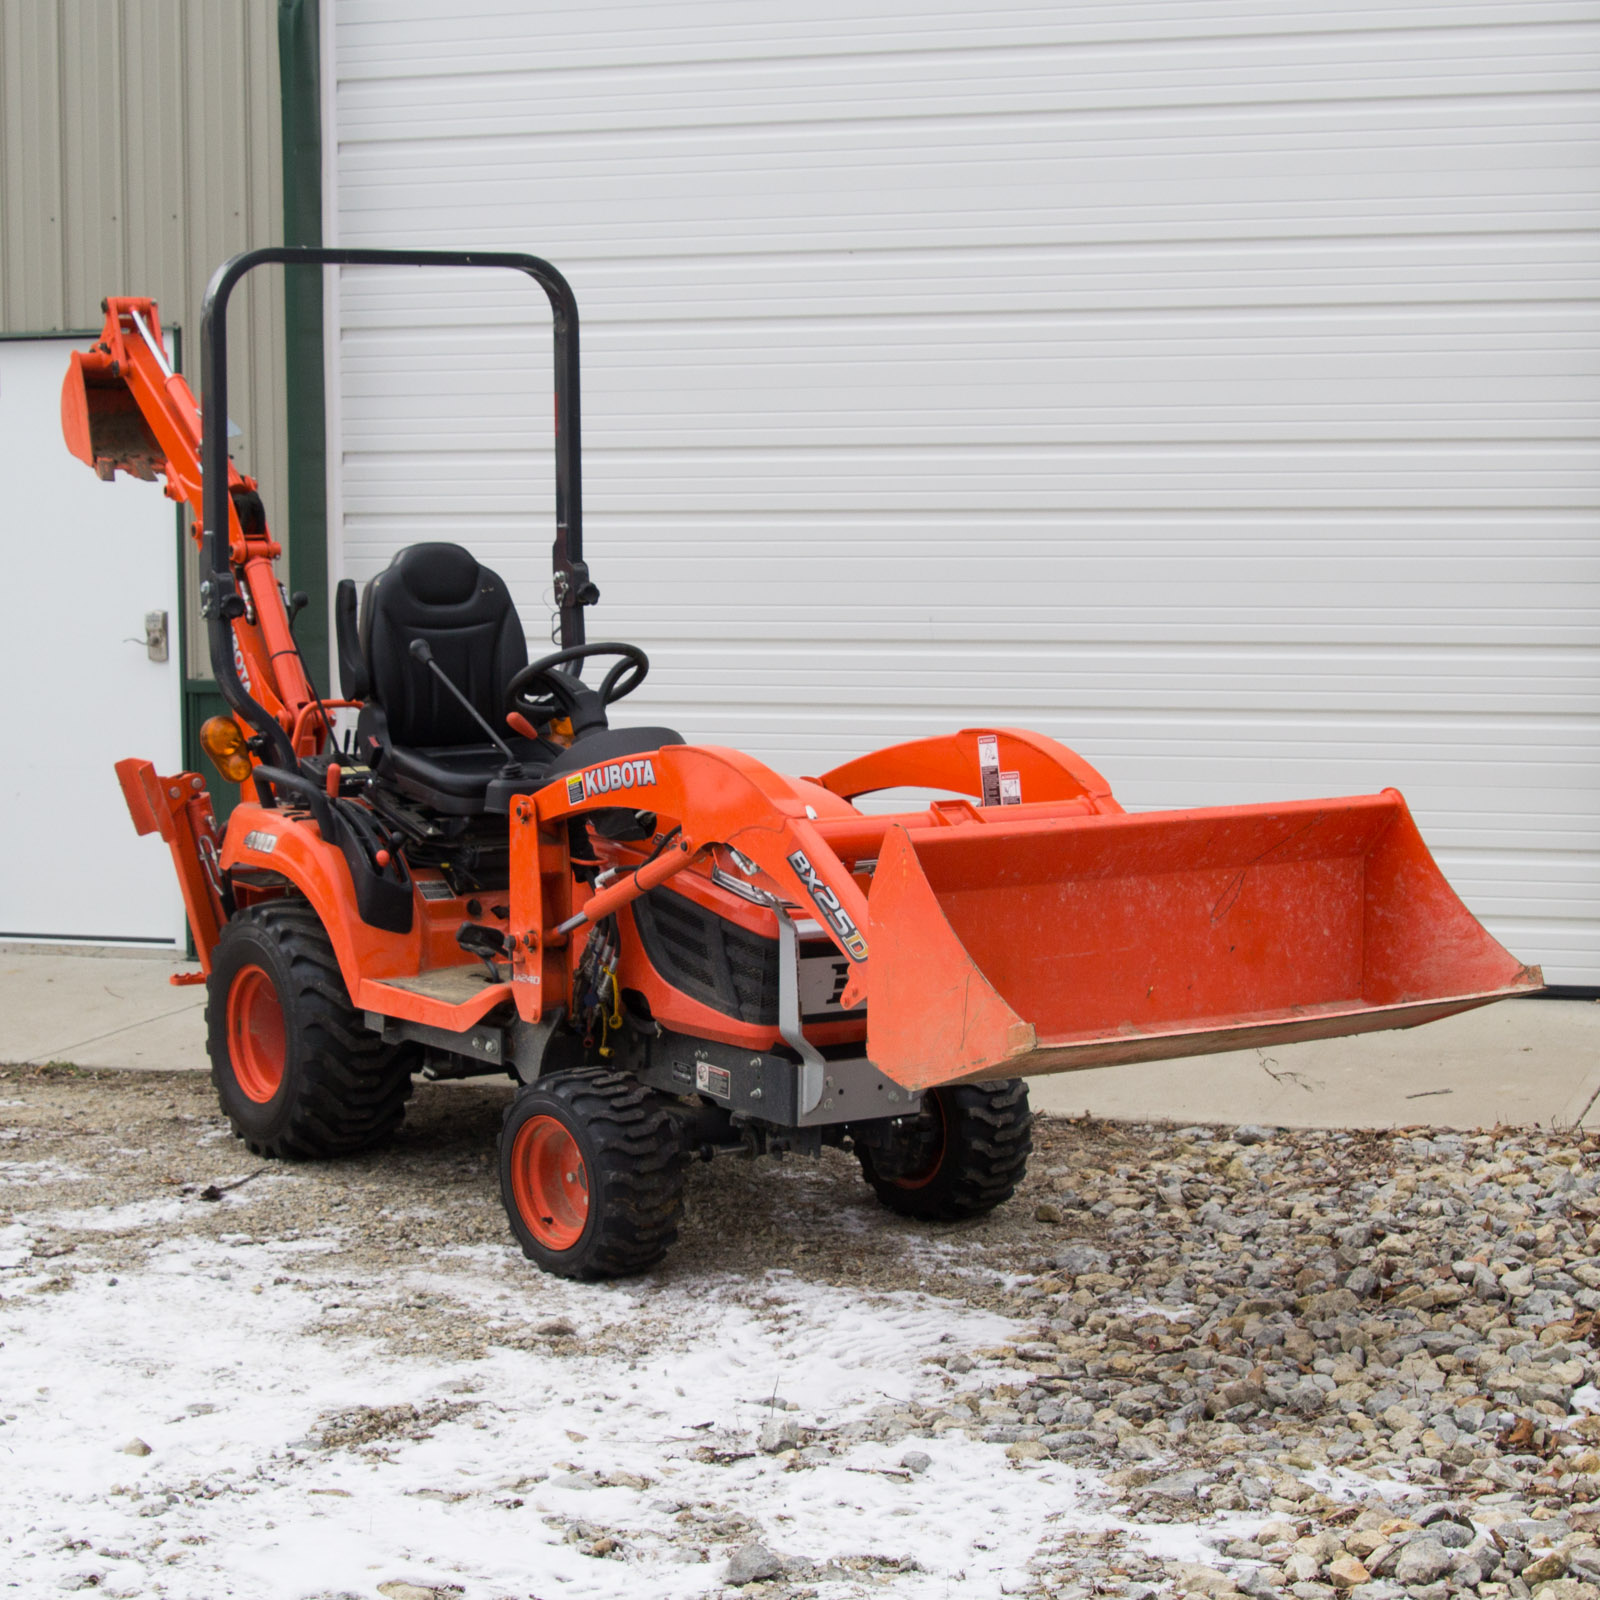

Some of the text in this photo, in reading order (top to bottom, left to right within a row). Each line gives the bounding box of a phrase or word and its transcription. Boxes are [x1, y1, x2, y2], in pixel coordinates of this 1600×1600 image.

[585, 760, 656, 796] KUBOTA
[244, 830, 278, 854] 4WD
[787, 850, 868, 963] BX25D
